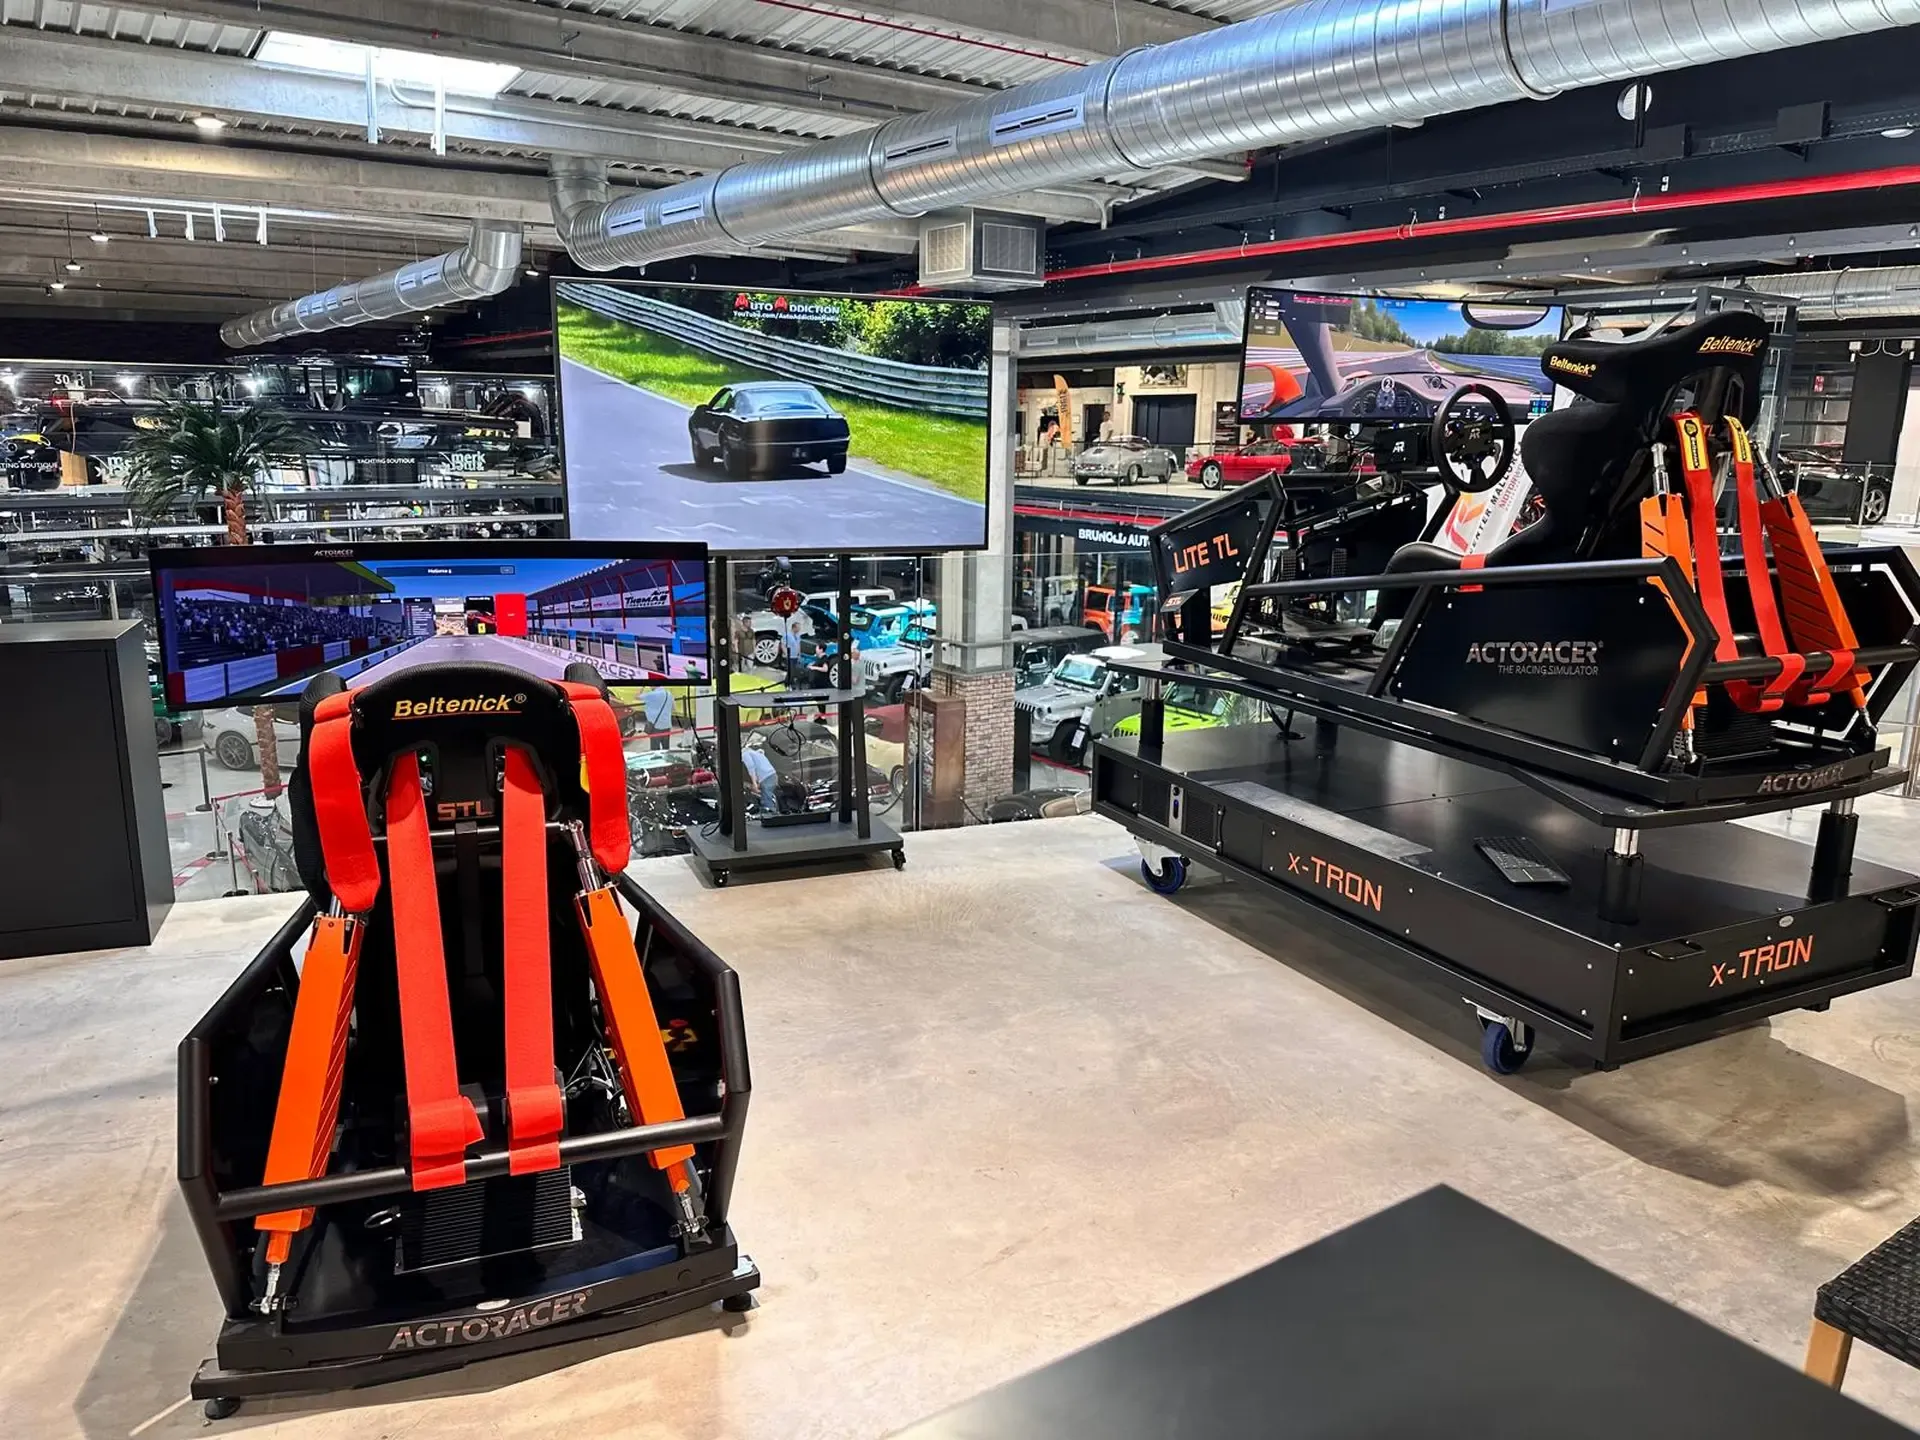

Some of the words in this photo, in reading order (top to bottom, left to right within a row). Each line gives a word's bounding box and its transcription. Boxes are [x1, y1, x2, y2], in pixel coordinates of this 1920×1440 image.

[54, 373, 70, 385] 30
[1703, 424, 1716, 437] TL
[1127, 534, 1150, 547] AUT
[1173, 541, 1210, 573] LITE
[1212, 533, 1239, 560] TL
[83, 586, 99, 596] 32
[1498, 664, 1514, 675] THE
[1515, 664, 1547, 675] RACING
[1548, 665, 1599, 676] SIMULATOR
[437, 800, 494, 821] STL
